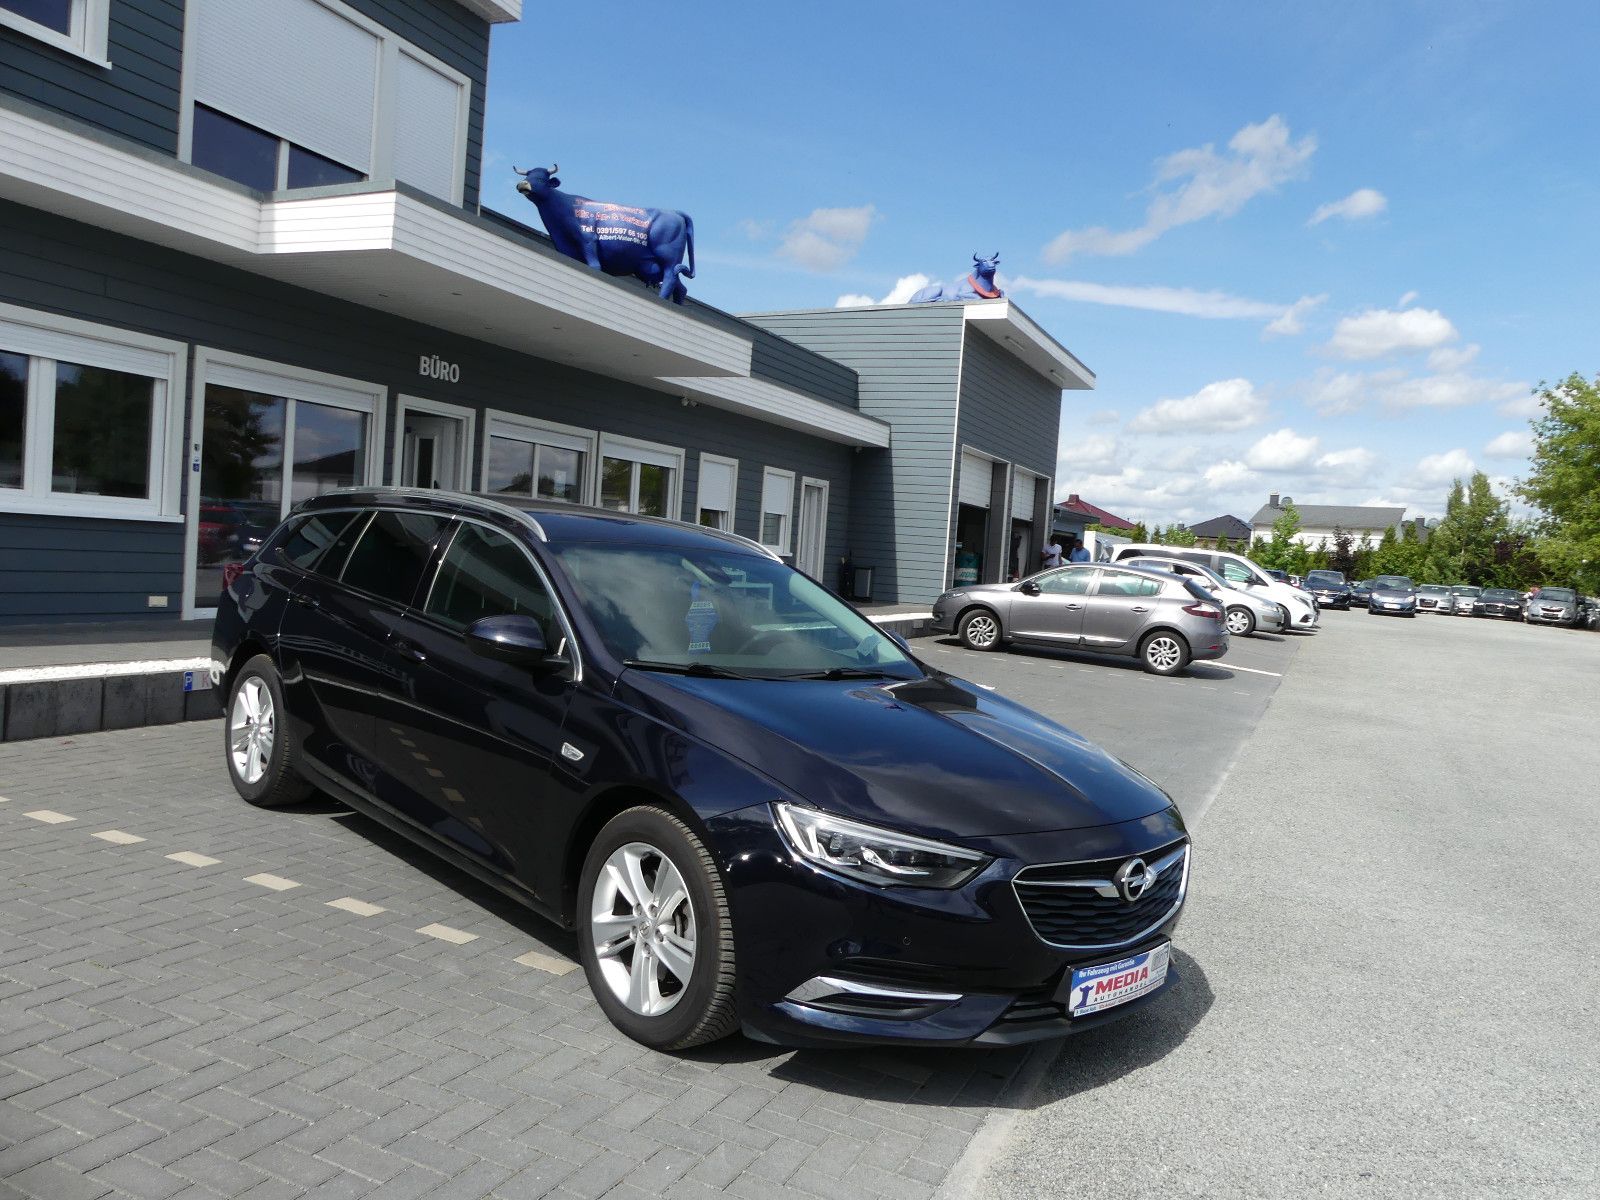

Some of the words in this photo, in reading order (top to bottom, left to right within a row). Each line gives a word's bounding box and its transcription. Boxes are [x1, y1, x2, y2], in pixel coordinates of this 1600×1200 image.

[419, 354, 460, 383] BÜRO
[1094, 982, 1147, 1003] AUTOHANDEL
[1095, 967, 1148, 995] MEDIA
